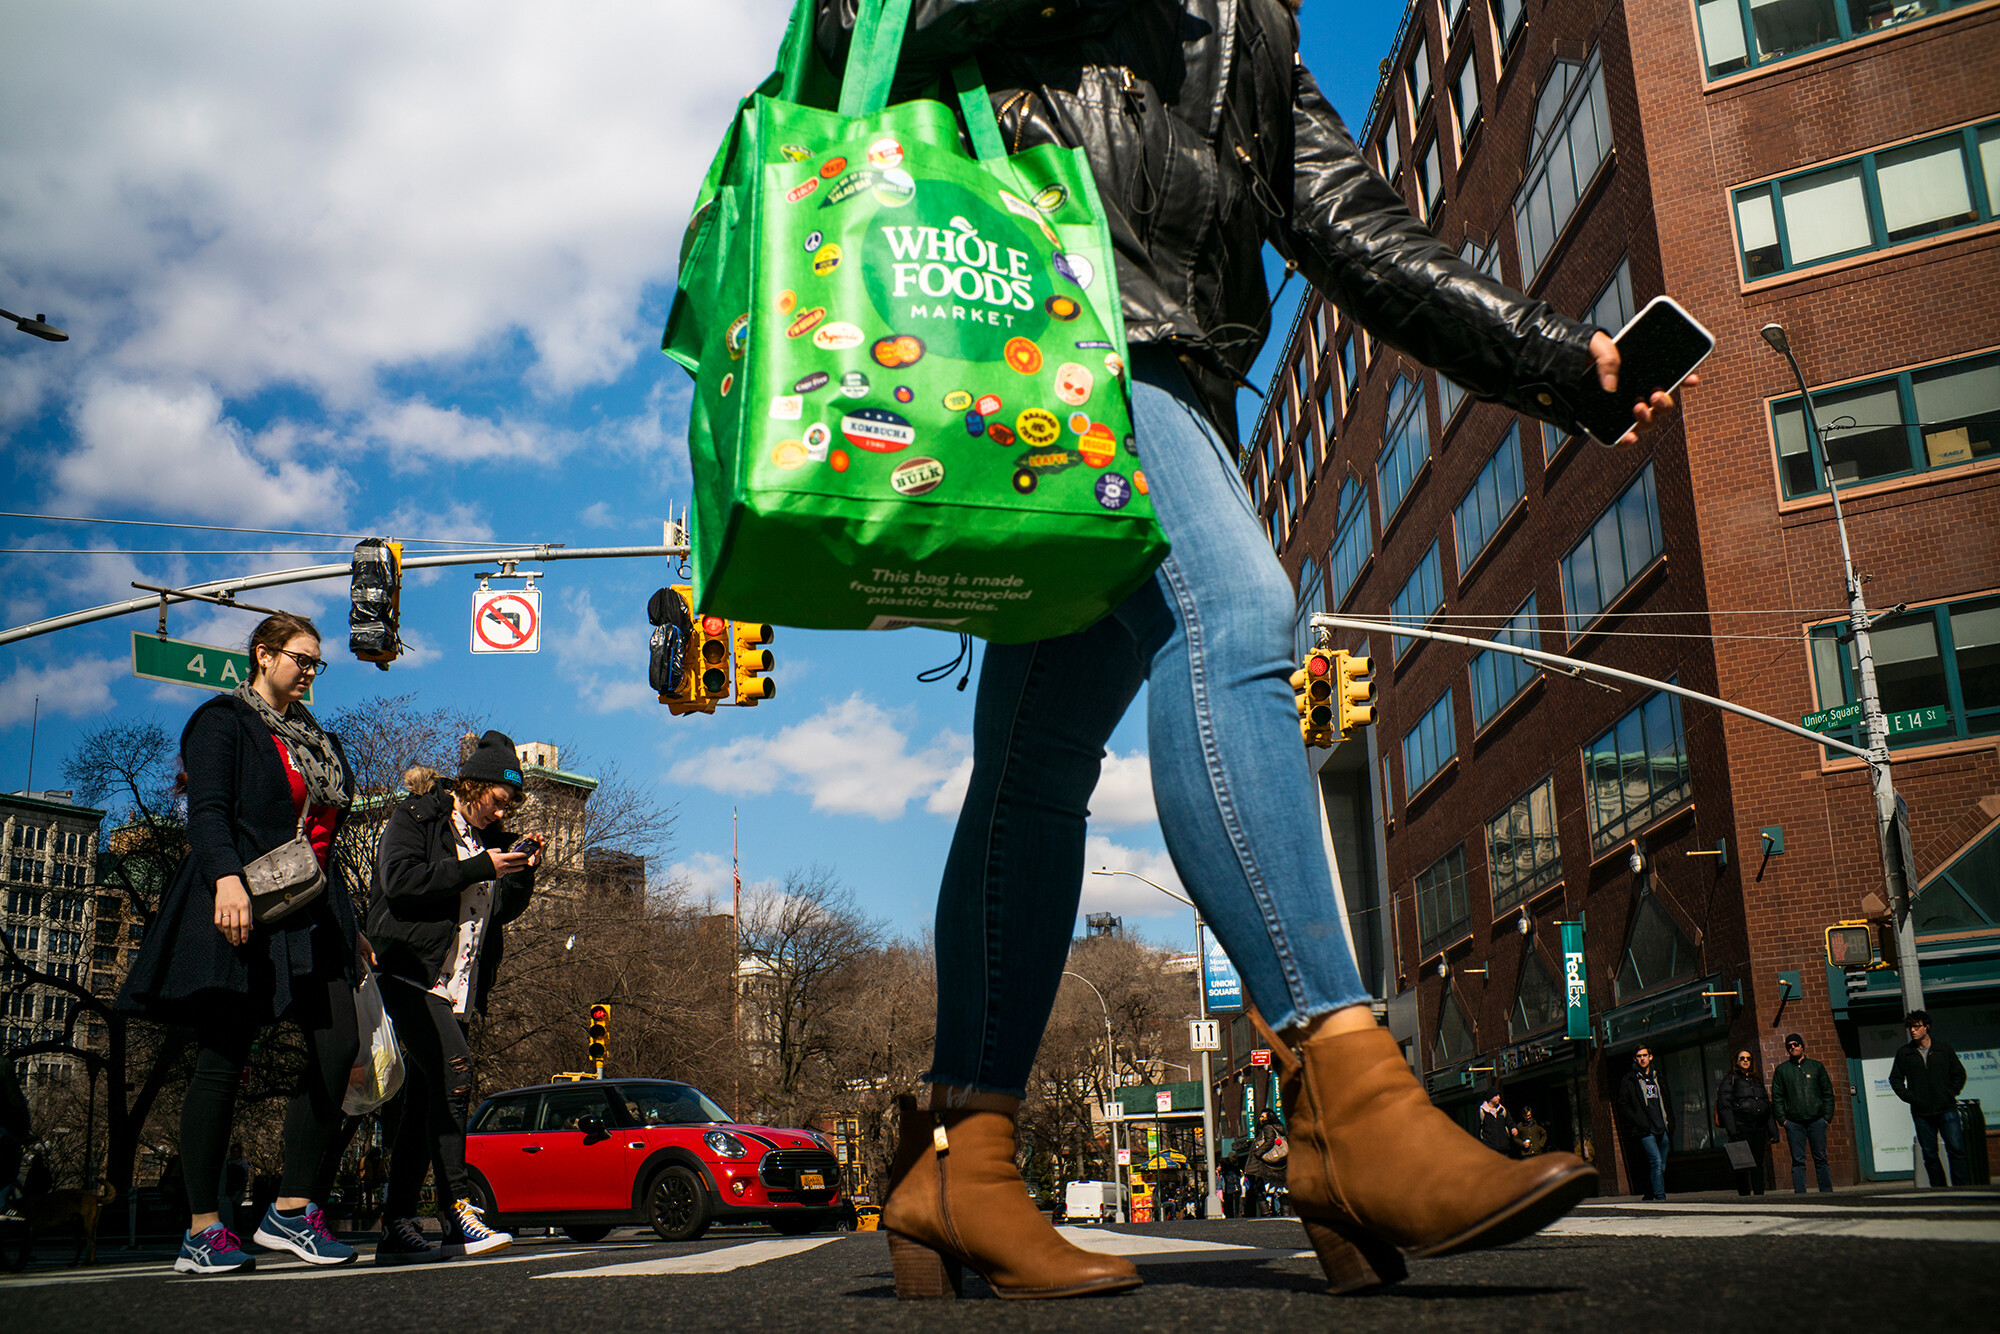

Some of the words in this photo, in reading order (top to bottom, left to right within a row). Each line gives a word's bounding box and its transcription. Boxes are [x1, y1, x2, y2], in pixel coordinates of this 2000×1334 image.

[881, 220, 1032, 282] WHOLE
[892, 262, 1035, 311] FOODS
[910, 304, 1014, 328] MARKET
[850, 421, 907, 440] KOMBUCHA
[896, 467, 942, 489] BULK
[1104, 474, 1127, 487] BULK
[871, 568, 910, 584] This
[914, 570, 950, 587] bag
[953, 573, 969, 586] is
[972, 574, 1025, 588] made
[849, 580, 895, 595] from
[900, 586, 949, 597] 100%
[952, 588, 1034, 602] recycled
[867, 596, 930, 608] plastic
[932, 598, 999, 612] bottles.
[186, 653, 207, 678] 4
[220, 659, 250, 683] A
[1804, 713, 1828, 727] Union
[1830, 704, 1860, 722] Square
[1827, 720, 1839, 728] East
[1894, 715, 1904, 731] E
[1907, 712, 1923, 729] 14
[1926, 710, 1937, 721] St
[1211, 979, 1236, 988] UNION
[1565, 952, 1586, 1008] FedEx
[1208, 987, 1241, 997] SQUARE
[1956, 1050, 1992, 1061] PRIME
[1247, 1087, 1256, 1113] GNC
